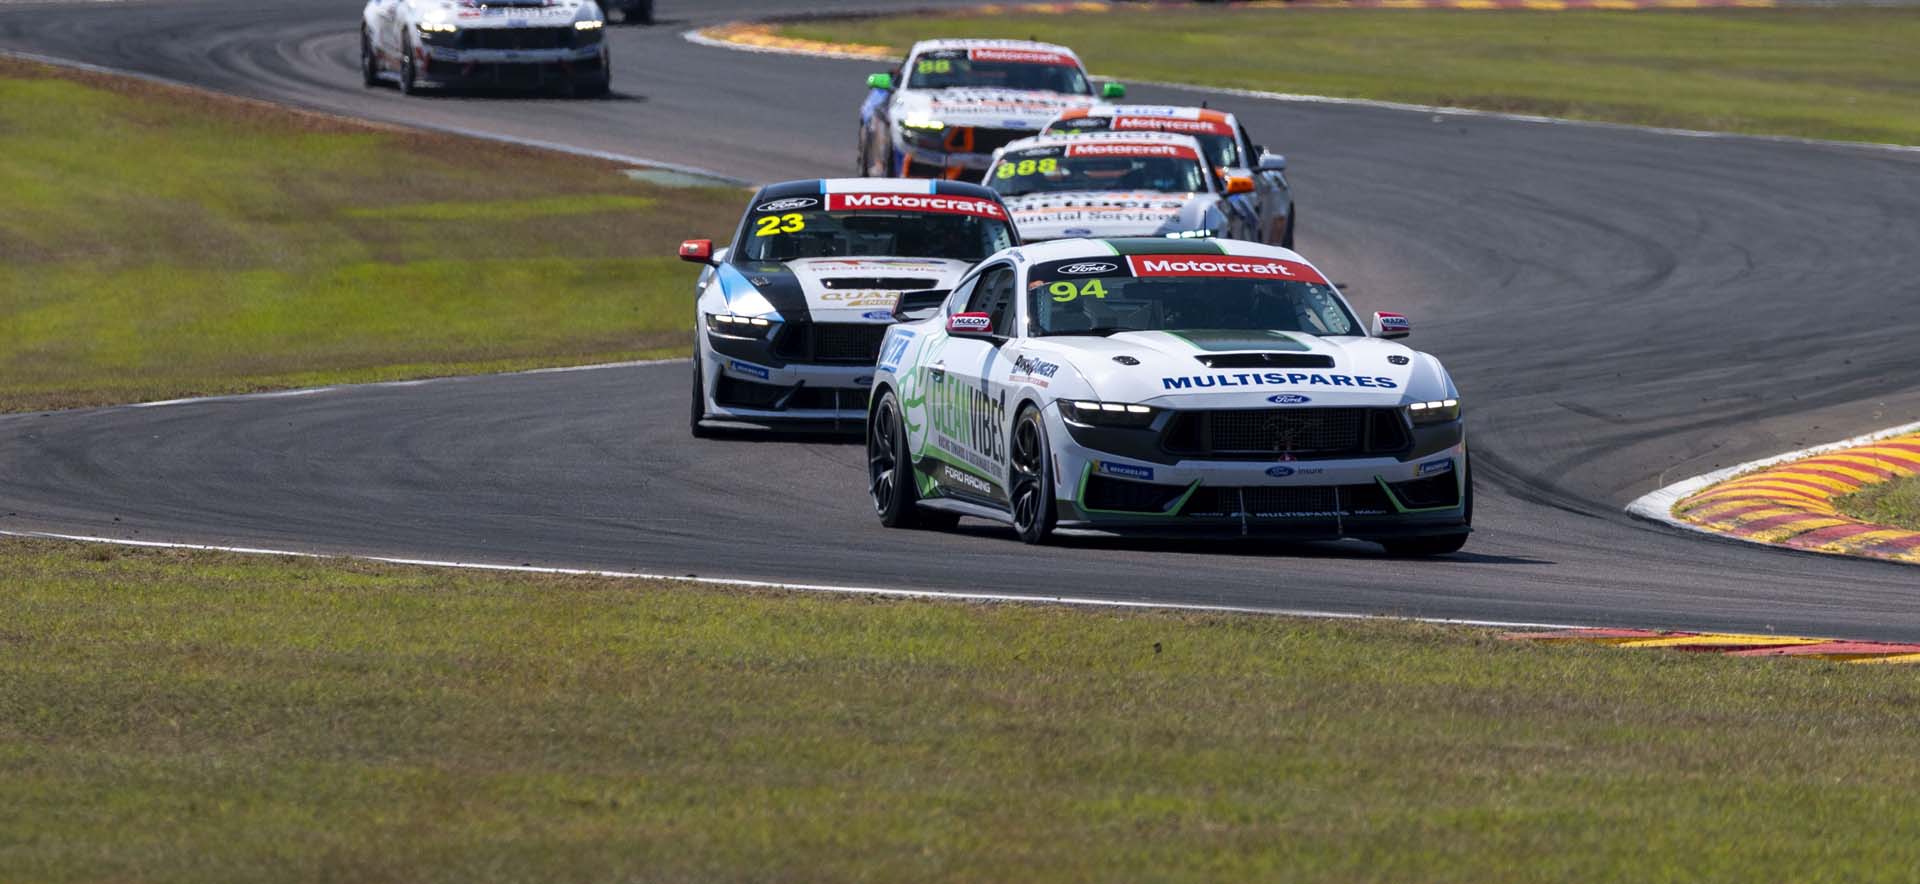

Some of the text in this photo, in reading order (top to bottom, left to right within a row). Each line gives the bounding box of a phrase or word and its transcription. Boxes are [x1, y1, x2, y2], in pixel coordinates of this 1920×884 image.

[976, 50, 1061, 63] Motorcraft
[918, 60, 950, 74] 88
[1120, 118, 1216, 131] Motorcraft
[1074, 144, 1178, 155] Motorcraft
[997, 158, 1057, 180] 888
[1088, 211, 1181, 223] Services
[756, 213, 806, 237] 23
[1049, 279, 1109, 303] 94
[1162, 372, 1398, 389] MULTISPARES
[945, 465, 991, 493] FORD RACING
